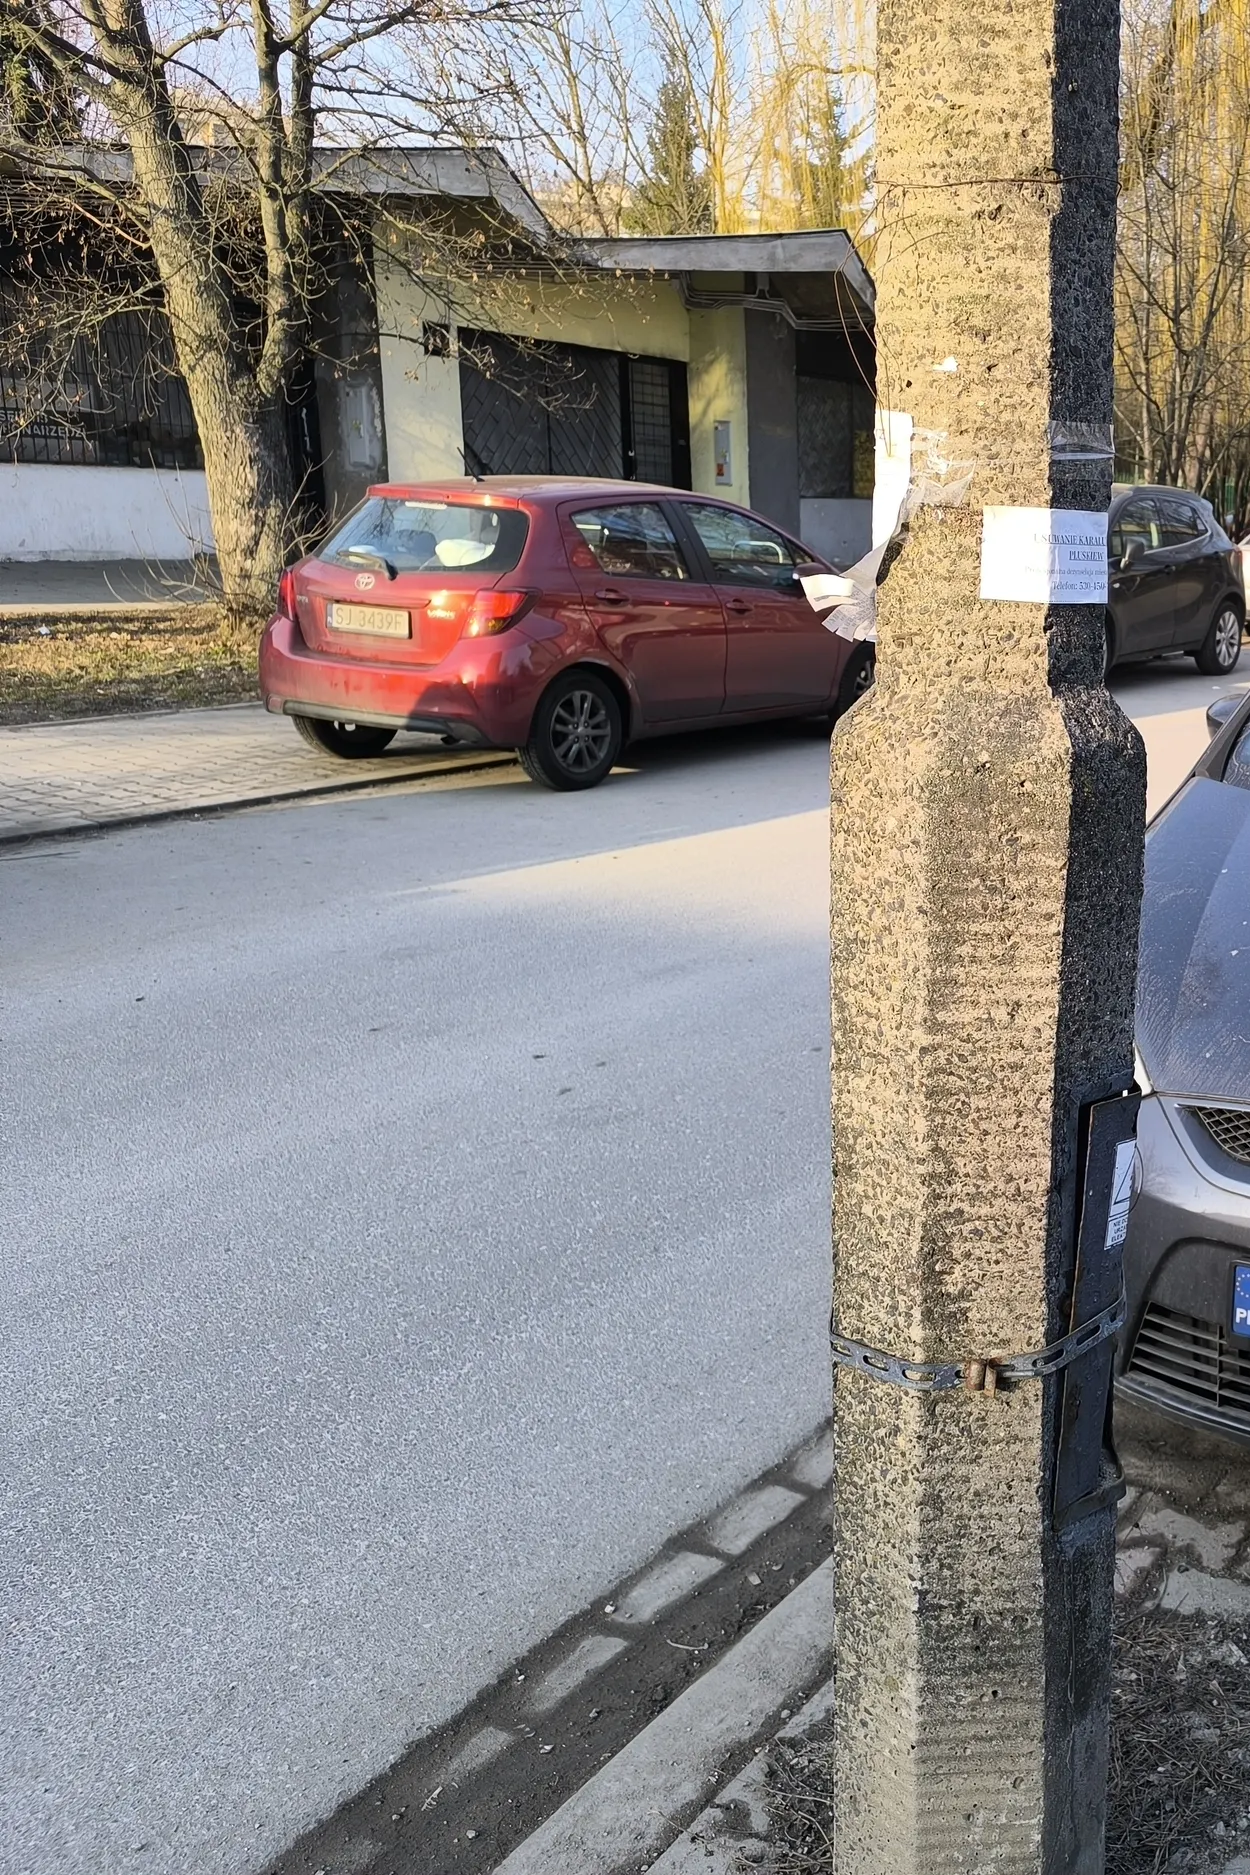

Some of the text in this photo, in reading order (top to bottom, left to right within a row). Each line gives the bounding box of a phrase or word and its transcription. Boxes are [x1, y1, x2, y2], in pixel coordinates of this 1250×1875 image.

[1069, 550, 1104, 561] PLUSKIEW
[1052, 581, 1078, 590] Telefon:
[335, 607, 404, 631] SJ 3439F
